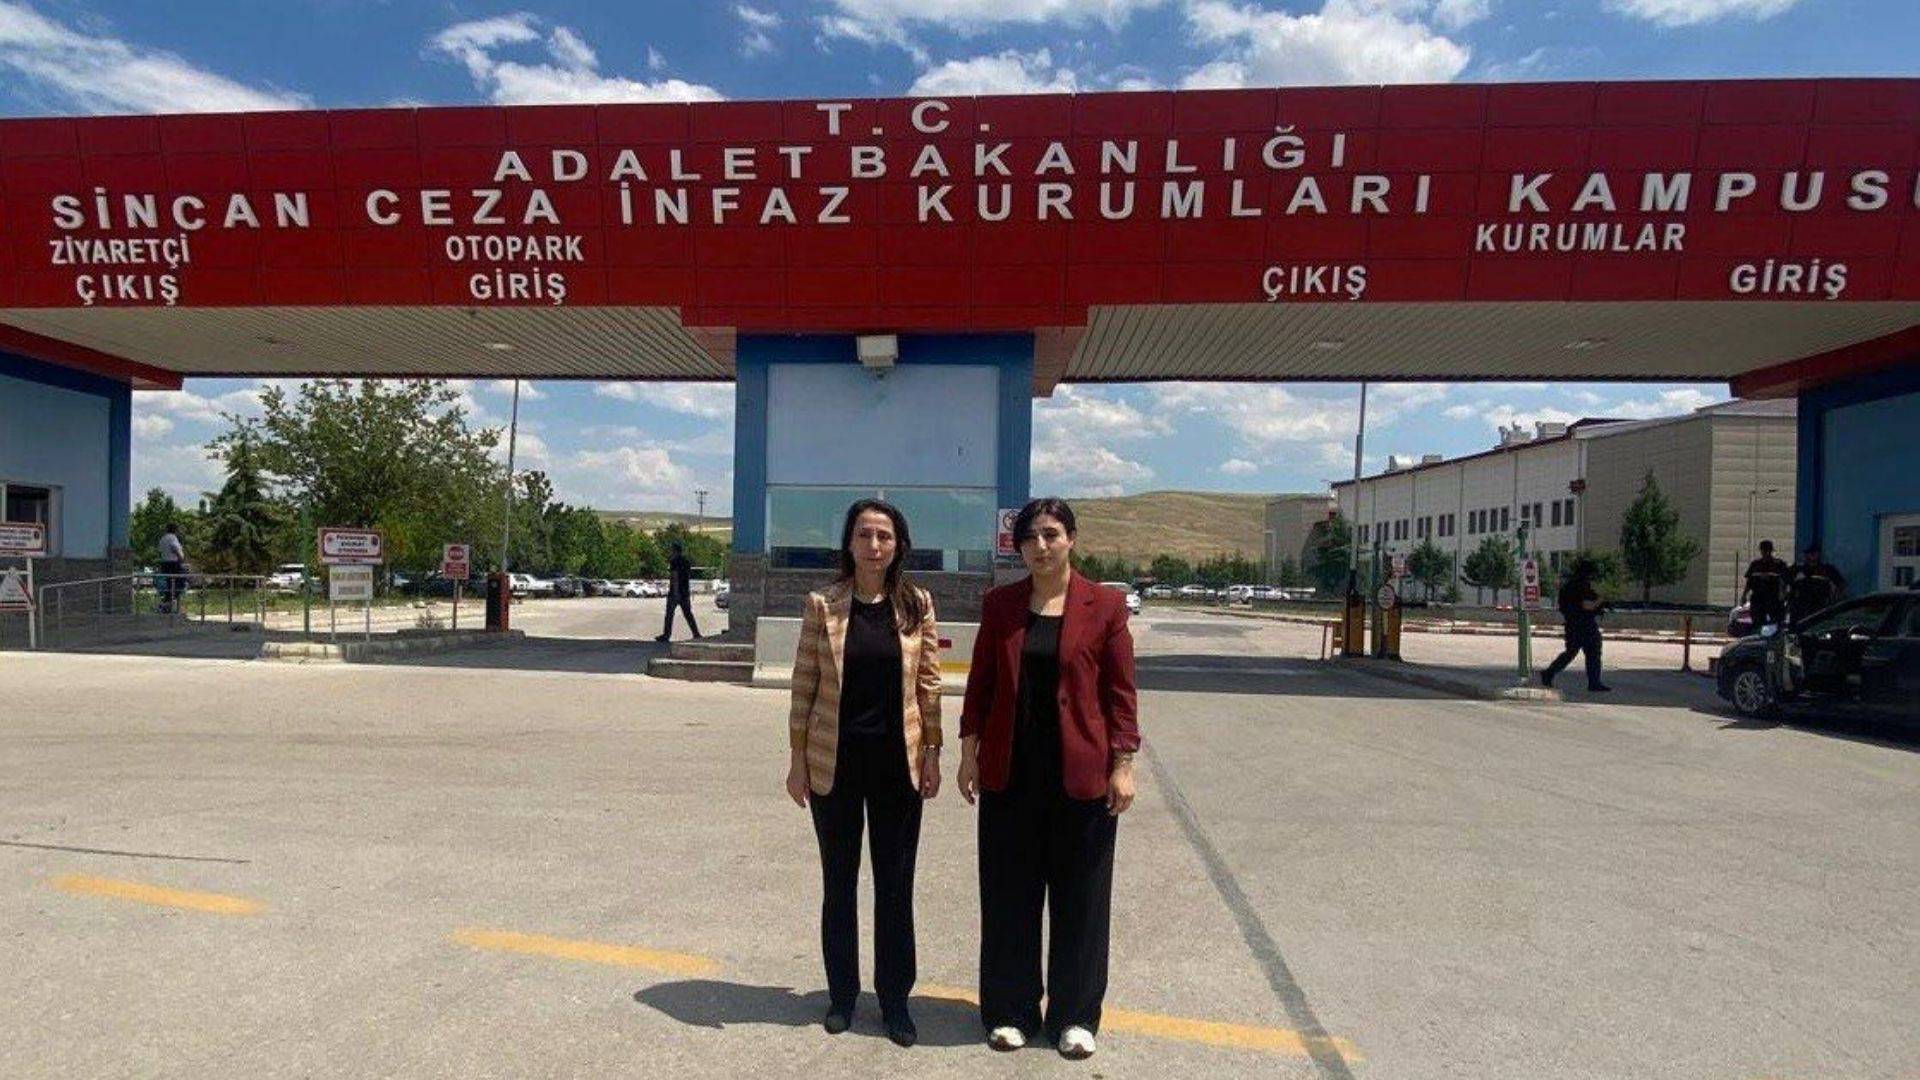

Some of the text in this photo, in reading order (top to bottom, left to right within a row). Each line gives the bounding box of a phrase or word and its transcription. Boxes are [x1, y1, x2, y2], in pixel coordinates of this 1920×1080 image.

[494, 125, 1345, 182] ADALET BAKANLIĞI
[53, 170, 1920, 229] SİNCAN CEZA İNFAZ KURUMLARI KAMPUS
[50, 233, 190, 268] ZİYARETÇİ
[446, 235, 584, 261] OTOPARK
[1475, 223, 1687, 252] KURUMLAR
[76, 274, 179, 306] ÇIKIŞ
[469, 268, 566, 305] GİRİŞ
[1262, 265, 1367, 301] ÇIKIŞ
[1731, 258, 1848, 300] GİRİŞ
